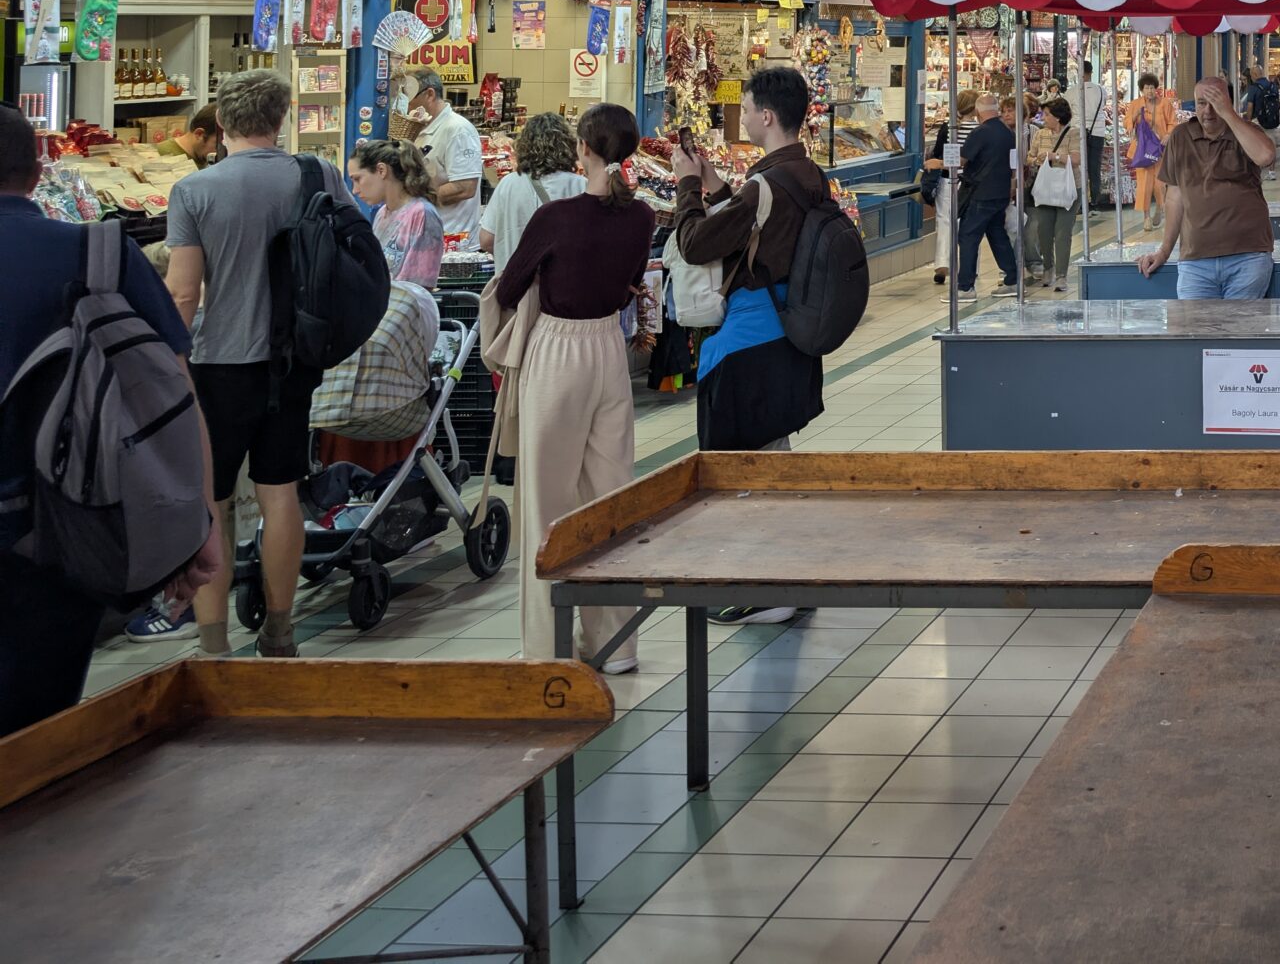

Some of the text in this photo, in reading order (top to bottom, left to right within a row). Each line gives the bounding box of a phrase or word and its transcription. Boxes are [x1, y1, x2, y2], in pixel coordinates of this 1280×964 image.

[1232, 409, 1256, 418] Bagoly
[1190, 553, 1214, 582] G
[544, 676, 572, 708] G
